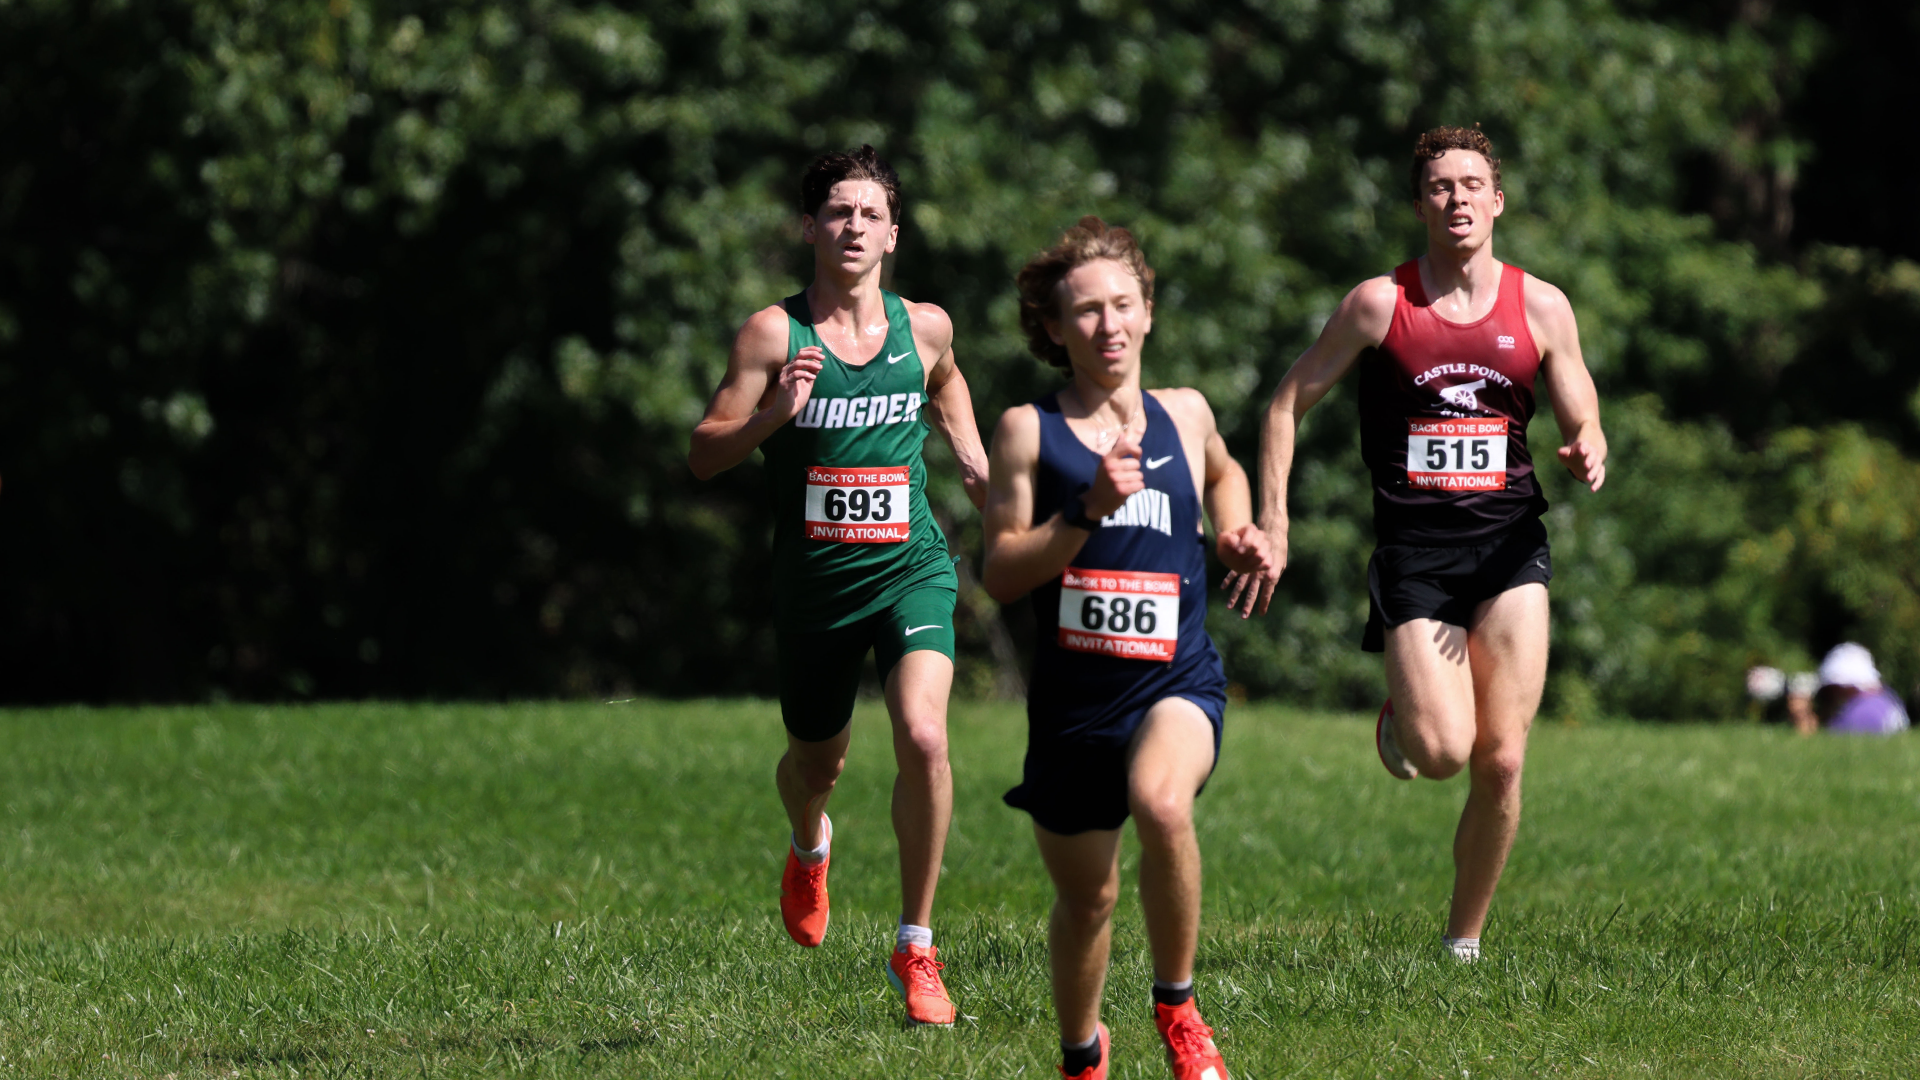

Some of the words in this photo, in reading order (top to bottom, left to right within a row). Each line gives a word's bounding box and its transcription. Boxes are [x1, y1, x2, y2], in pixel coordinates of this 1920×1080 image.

[1414, 363, 1466, 386] CASTLE
[1469, 364, 1513, 388] POINT
[795, 392, 921, 428] WAGNER
[1411, 424, 1439, 432] BACK
[1441, 424, 1455, 433] TO
[1457, 424, 1476, 433] THE
[1478, 424, 1506, 432] BOWL
[1426, 439, 1489, 470] 515
[809, 473, 839, 483] BACK
[841, 474, 855, 483] TO
[857, 474, 877, 483] THE
[880, 473, 907, 482] BOWL
[1416, 475, 1499, 487] INVITATIONAL
[824, 488, 892, 522] 693
[813, 526, 902, 539] INVITATIONAL
[1064, 574, 1099, 589] BACK
[1100, 577, 1117, 590] TO
[1118, 578, 1142, 591] THE
[1143, 580, 1178, 593] BOWL
[1081, 595, 1156, 634] 686
[1066, 634, 1169, 656] INVITATIONAL
